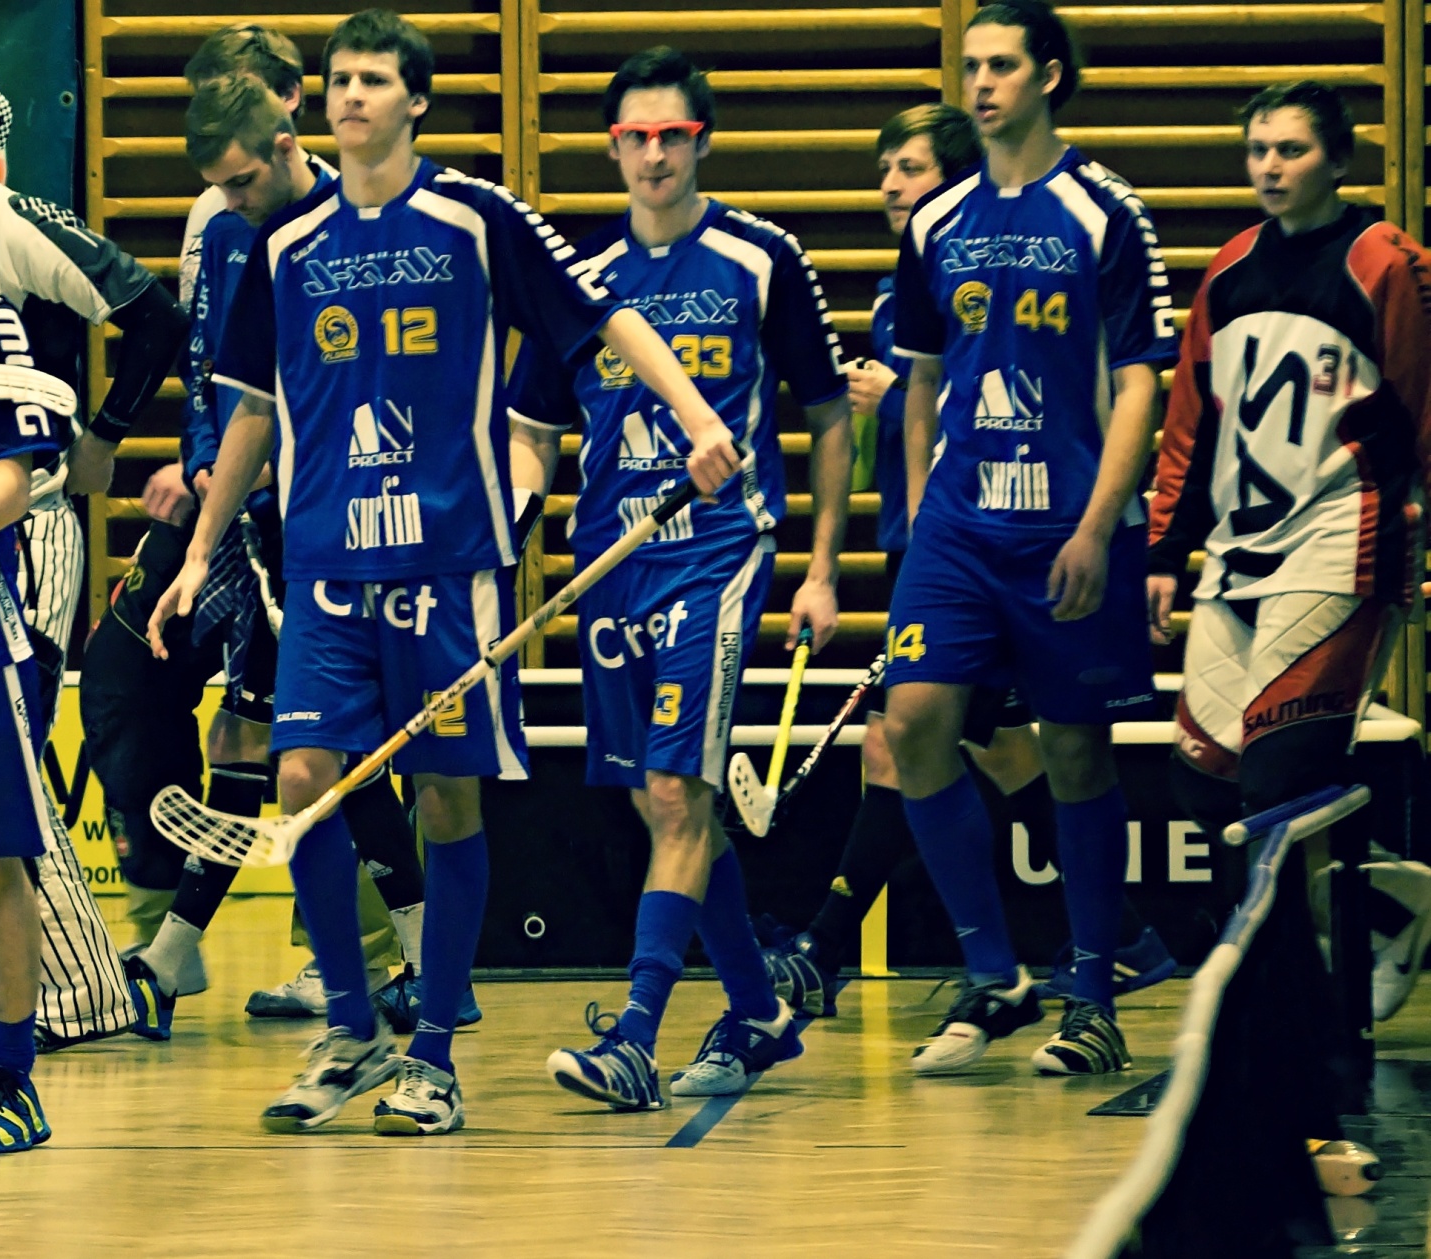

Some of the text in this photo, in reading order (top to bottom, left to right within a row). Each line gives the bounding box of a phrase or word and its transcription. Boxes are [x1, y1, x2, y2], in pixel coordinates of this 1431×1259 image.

[381, 307, 439, 355] 12
[1015, 288, 1070, 336] 44
[671, 333, 733, 379] 33
